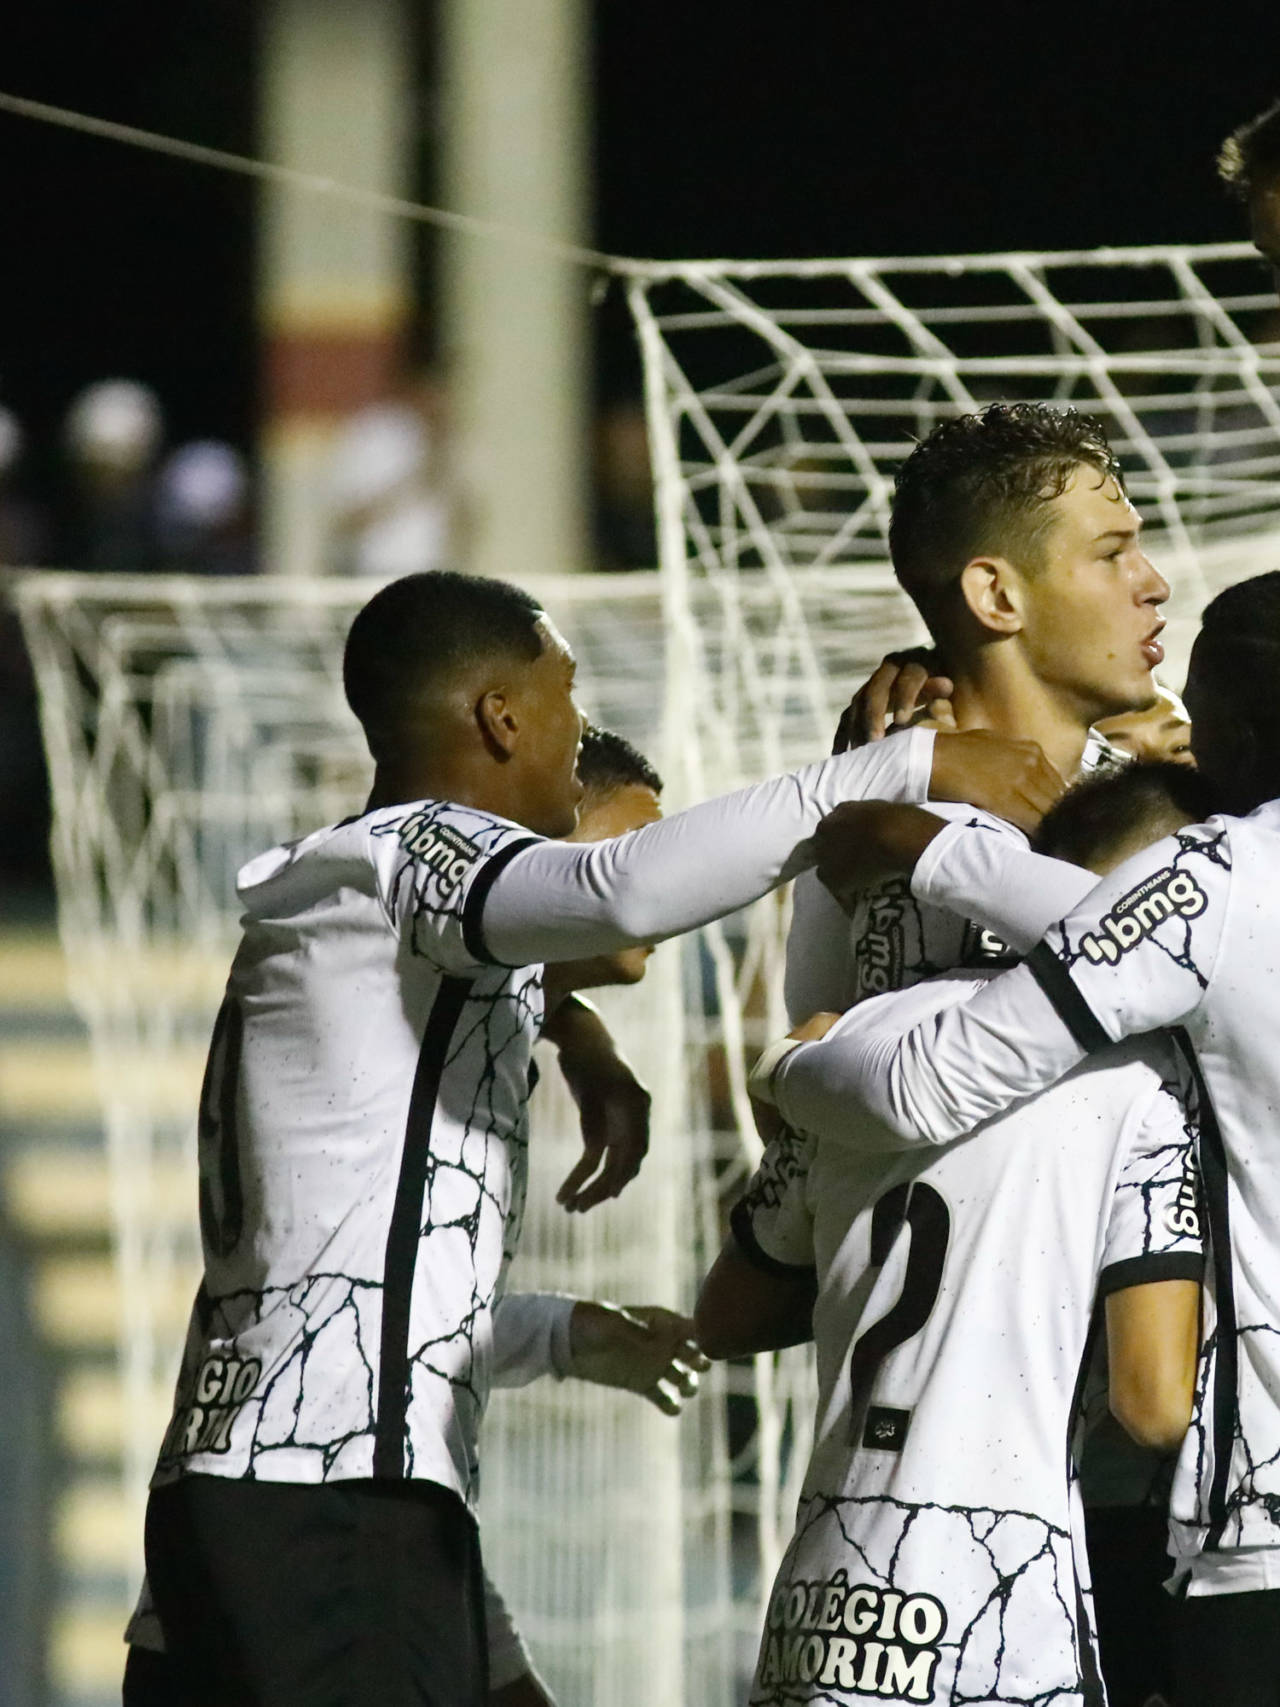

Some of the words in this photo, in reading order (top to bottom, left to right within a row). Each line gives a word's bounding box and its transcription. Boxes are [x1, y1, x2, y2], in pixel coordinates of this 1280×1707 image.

[410, 824, 471, 896] bmg
[1117, 870, 1171, 914] CORINTHIANS
[1105, 873, 1204, 949] bmg
[850, 1180, 950, 1452] 2
[768, 1570, 943, 1646] COLÉGIO
[762, 1632, 937, 1700] AMORIM
